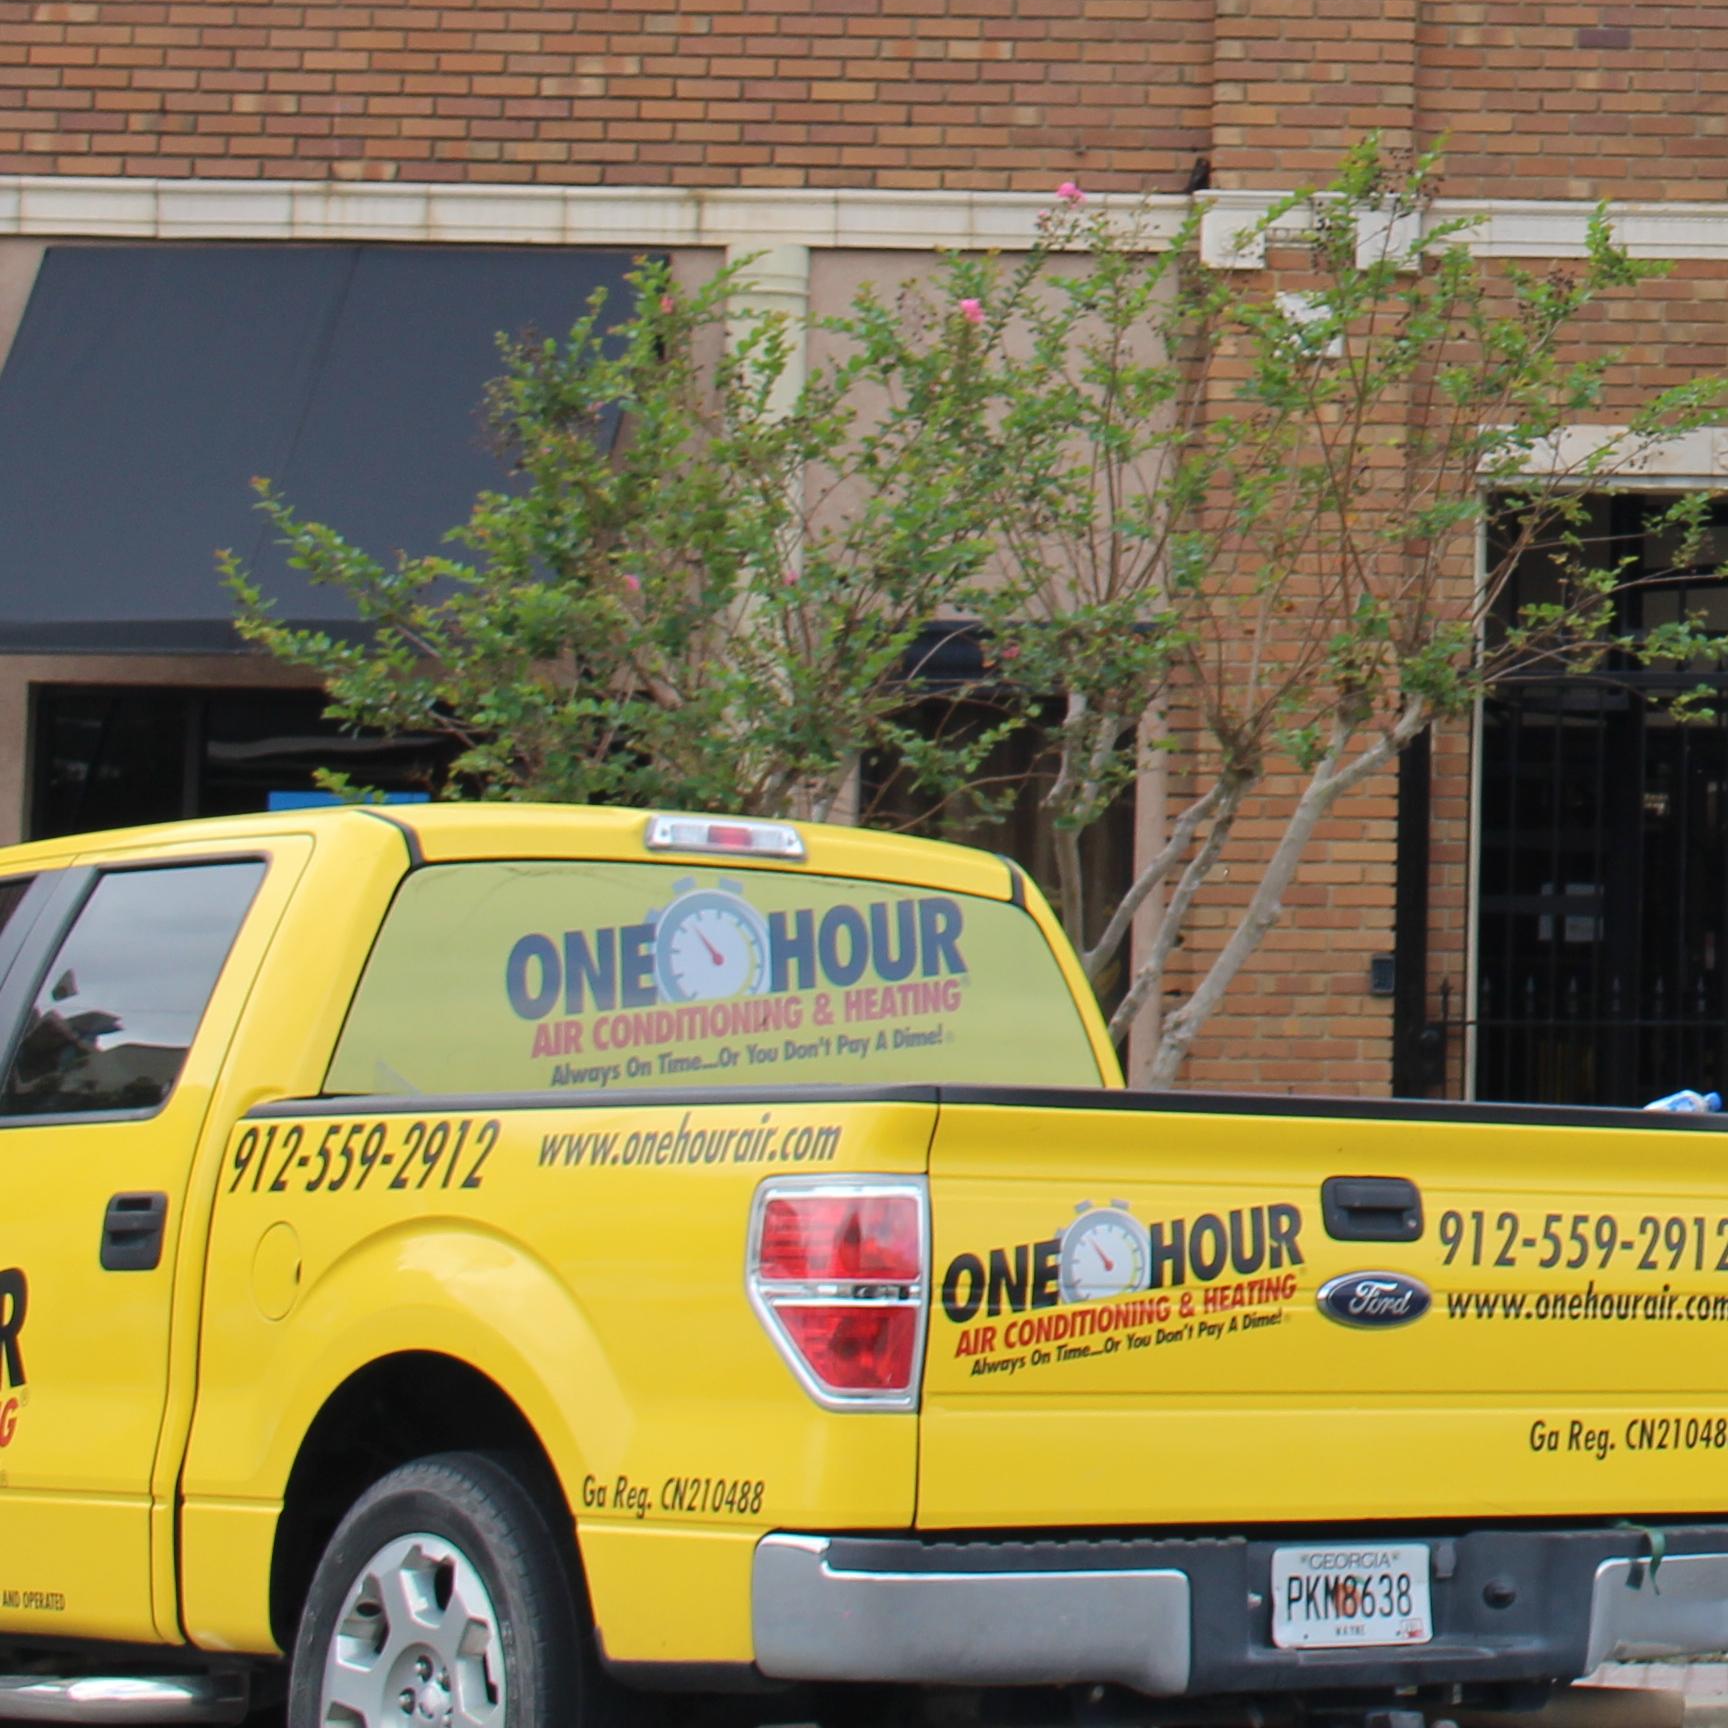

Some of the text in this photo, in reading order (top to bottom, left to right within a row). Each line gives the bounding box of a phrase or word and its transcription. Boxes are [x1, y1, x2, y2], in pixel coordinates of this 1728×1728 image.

[506, 896, 968, 1020] ONE HOUR
[532, 978, 962, 1058] AIR CONDITIONING & HEATING
[551, 1057, 621, 1087] Always
[626, 1057, 652, 1078] On
[747, 1046, 778, 1065] You
[784, 1035, 831, 1060] Don't
[837, 1034, 870, 1058] Pay
[875, 1033, 888, 1050] A
[893, 1024, 943, 1047] Dime!
[229, 1119, 501, 1193] 912-559-2912
[537, 1113, 843, 1167] www.onehourair.com
[941, 1203, 1304, 1323] ONE HOUR
[955, 1274, 1297, 1358] AIR CONDITIONING & HEATING
[1348, 1280, 1413, 1315] Ford
[971, 1355, 1026, 1377] Always
[1031, 1350, 1051, 1366] On
[1126, 1333, 1150, 1350] You
[1156, 1322, 1193, 1345] Don't
[1198, 1320, 1225, 1340] Pay
[1229, 1316, 1238, 1332] A
[1242, 1309, 1283, 1329] Dime!
[1529, 1420, 1560, 1452] Ga
[1568, 1421, 1616, 1459] Reg.
[583, 1475, 764, 1519] Ga Reg. CN210488
[1310, 1552, 1391, 1570] GEORGIA
[1287, 1573, 1412, 1622] PKM8638
